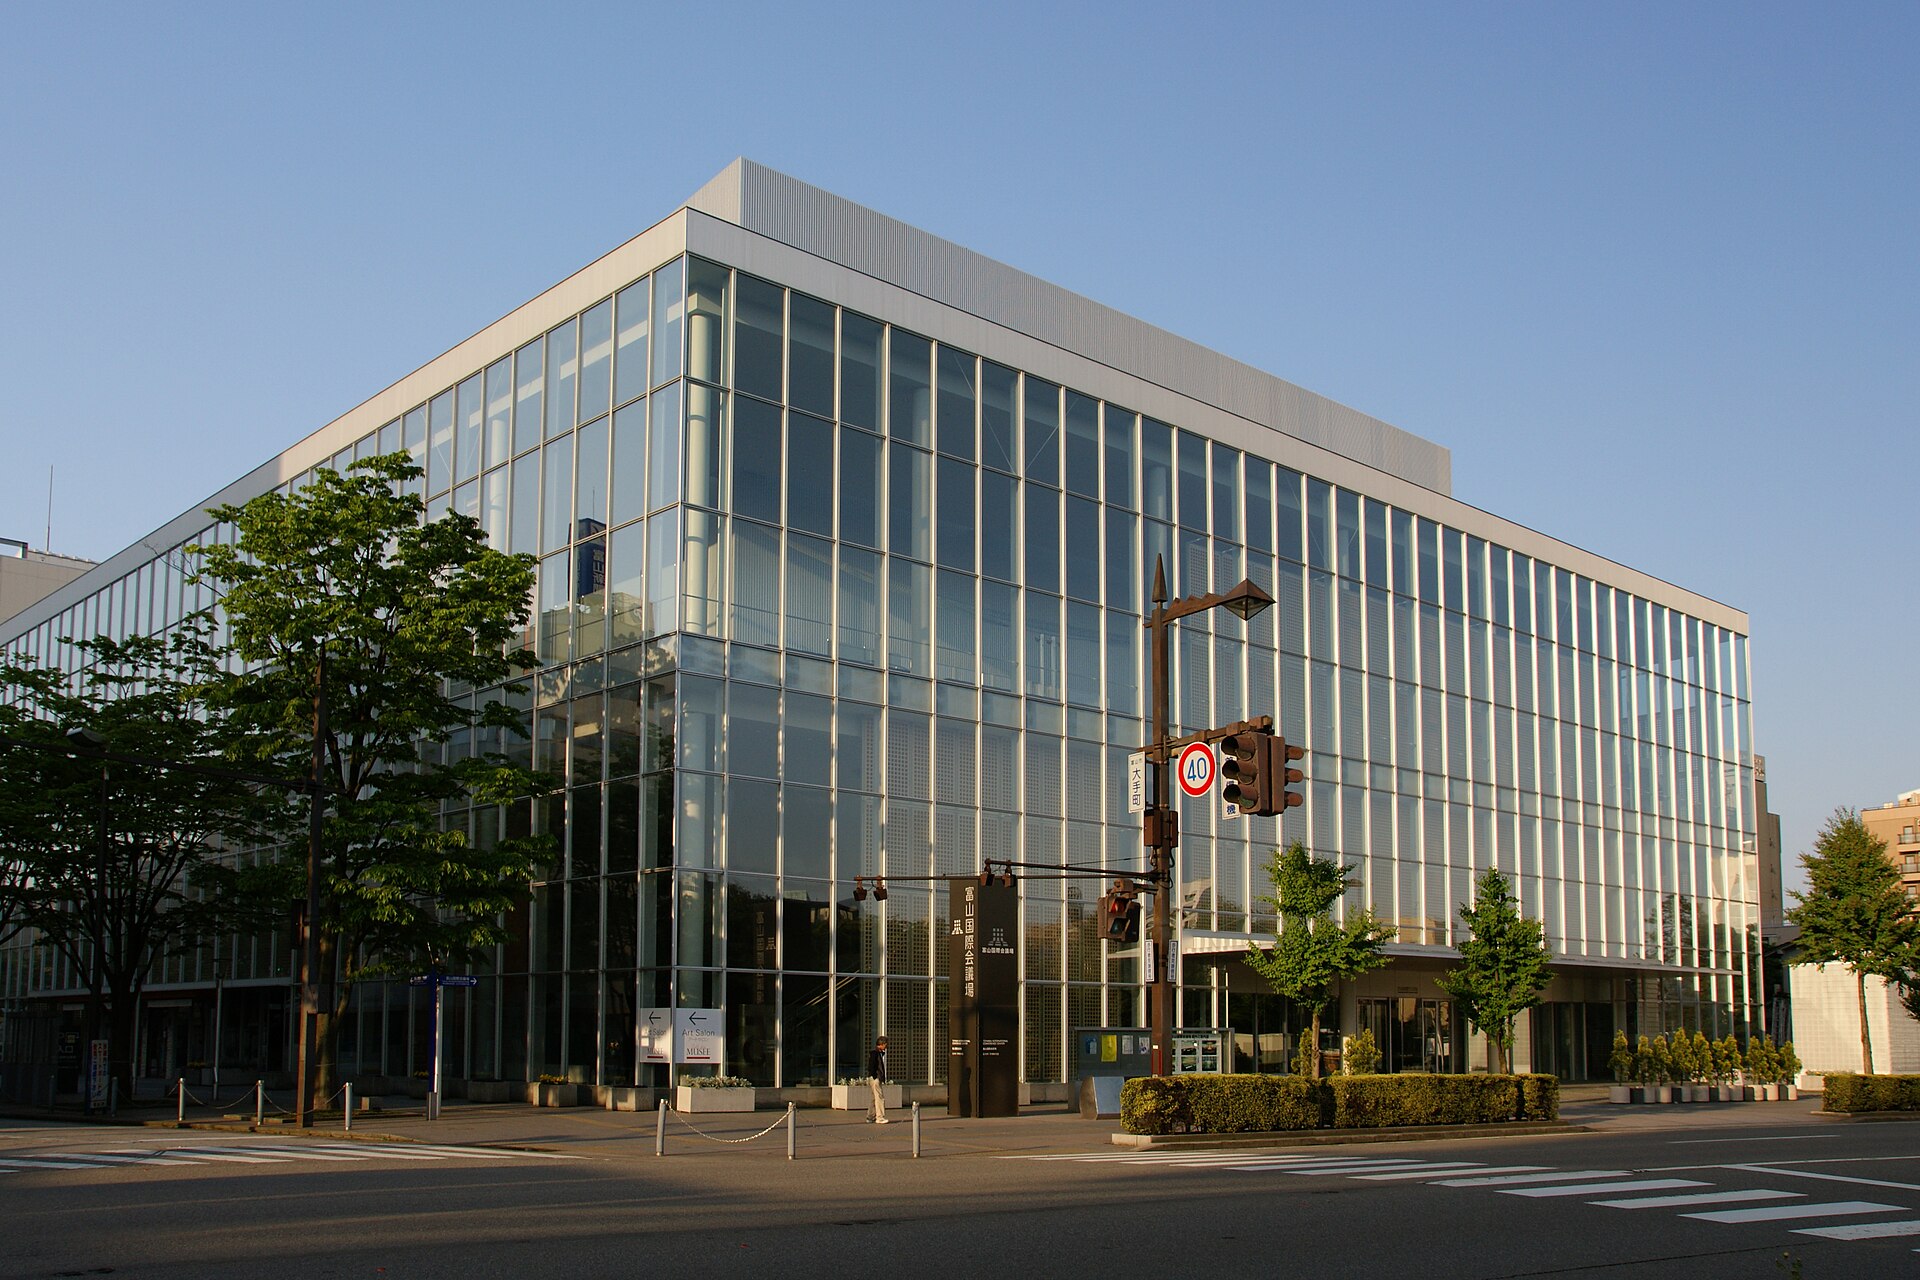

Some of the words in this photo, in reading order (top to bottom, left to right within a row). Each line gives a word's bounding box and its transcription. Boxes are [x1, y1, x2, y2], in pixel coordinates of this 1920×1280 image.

[1132, 768, 1141, 806] 大手町
[1187, 757, 1207, 781] 40
[964, 886, 975, 997] 富山国際会議場
